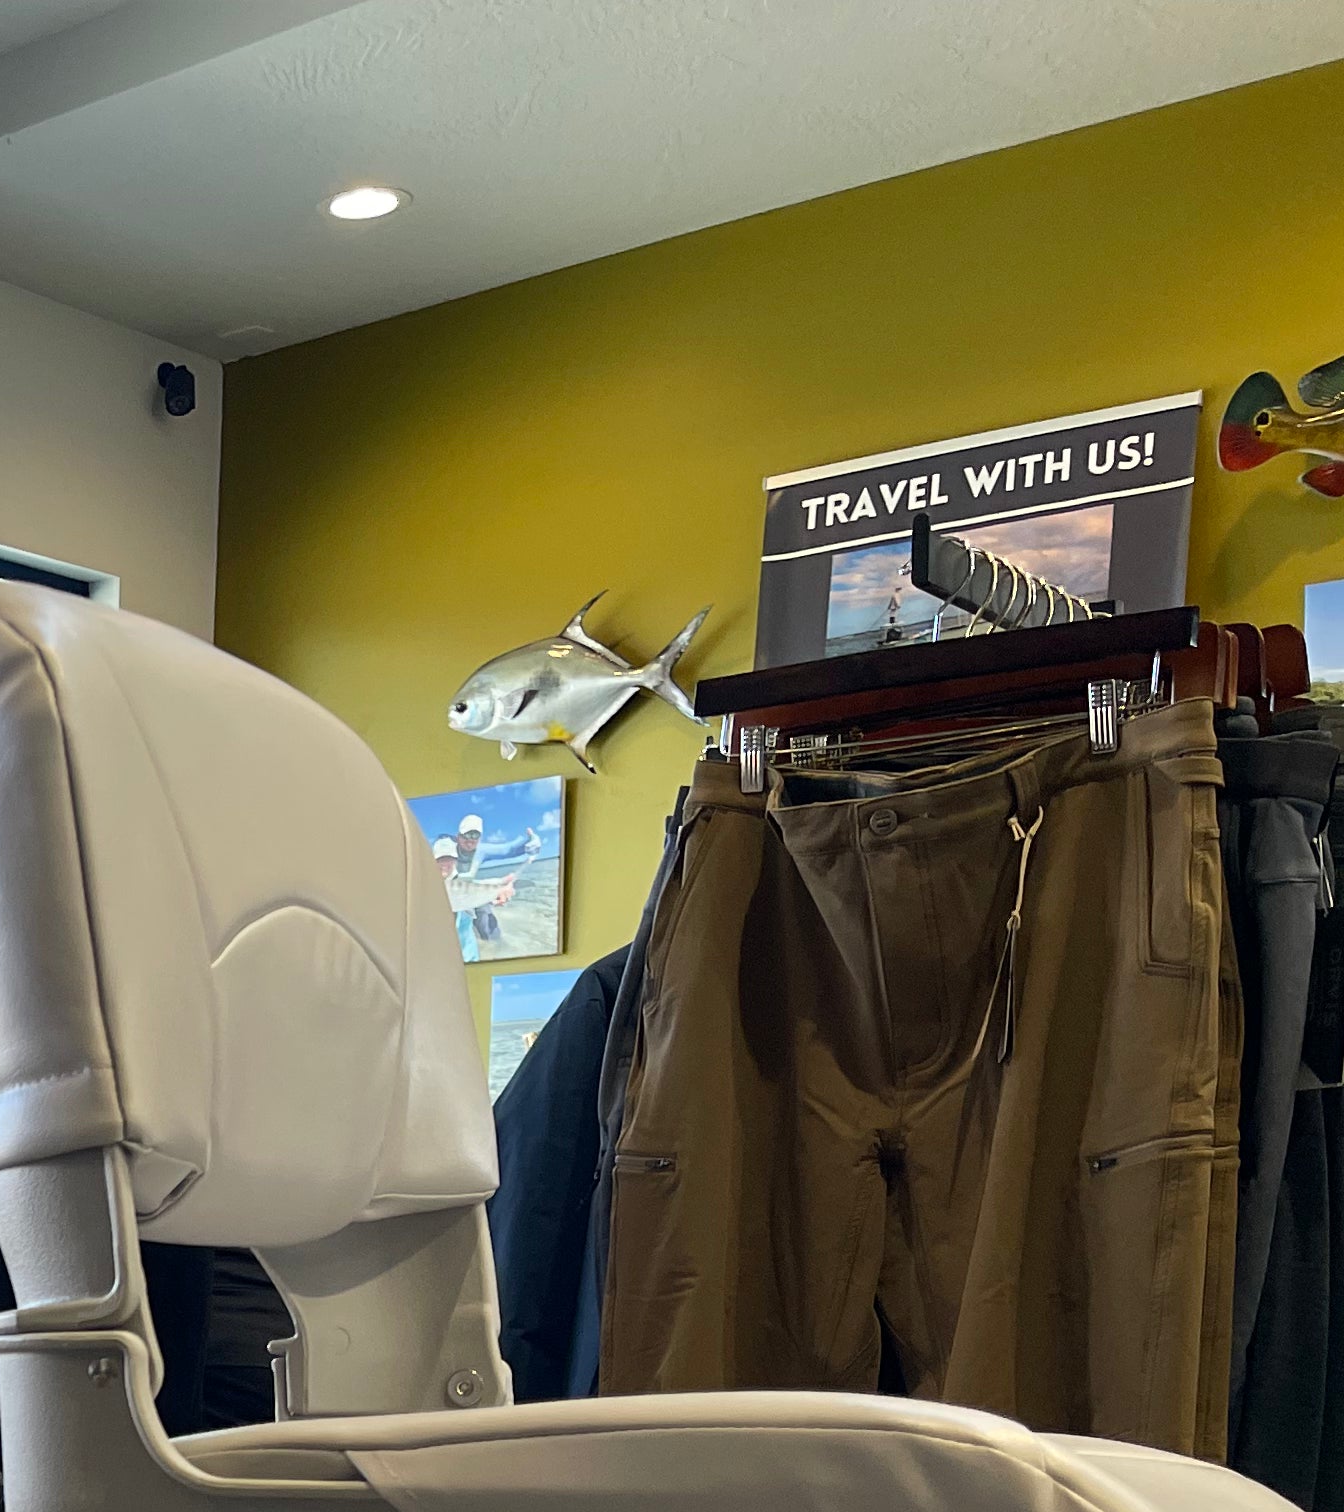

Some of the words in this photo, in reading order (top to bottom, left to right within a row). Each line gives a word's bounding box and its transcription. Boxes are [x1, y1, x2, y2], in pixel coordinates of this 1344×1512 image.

[801, 473, 949, 530] TRAVEL
[963, 448, 1072, 498] WITH
[1088, 432, 1155, 475] US!
